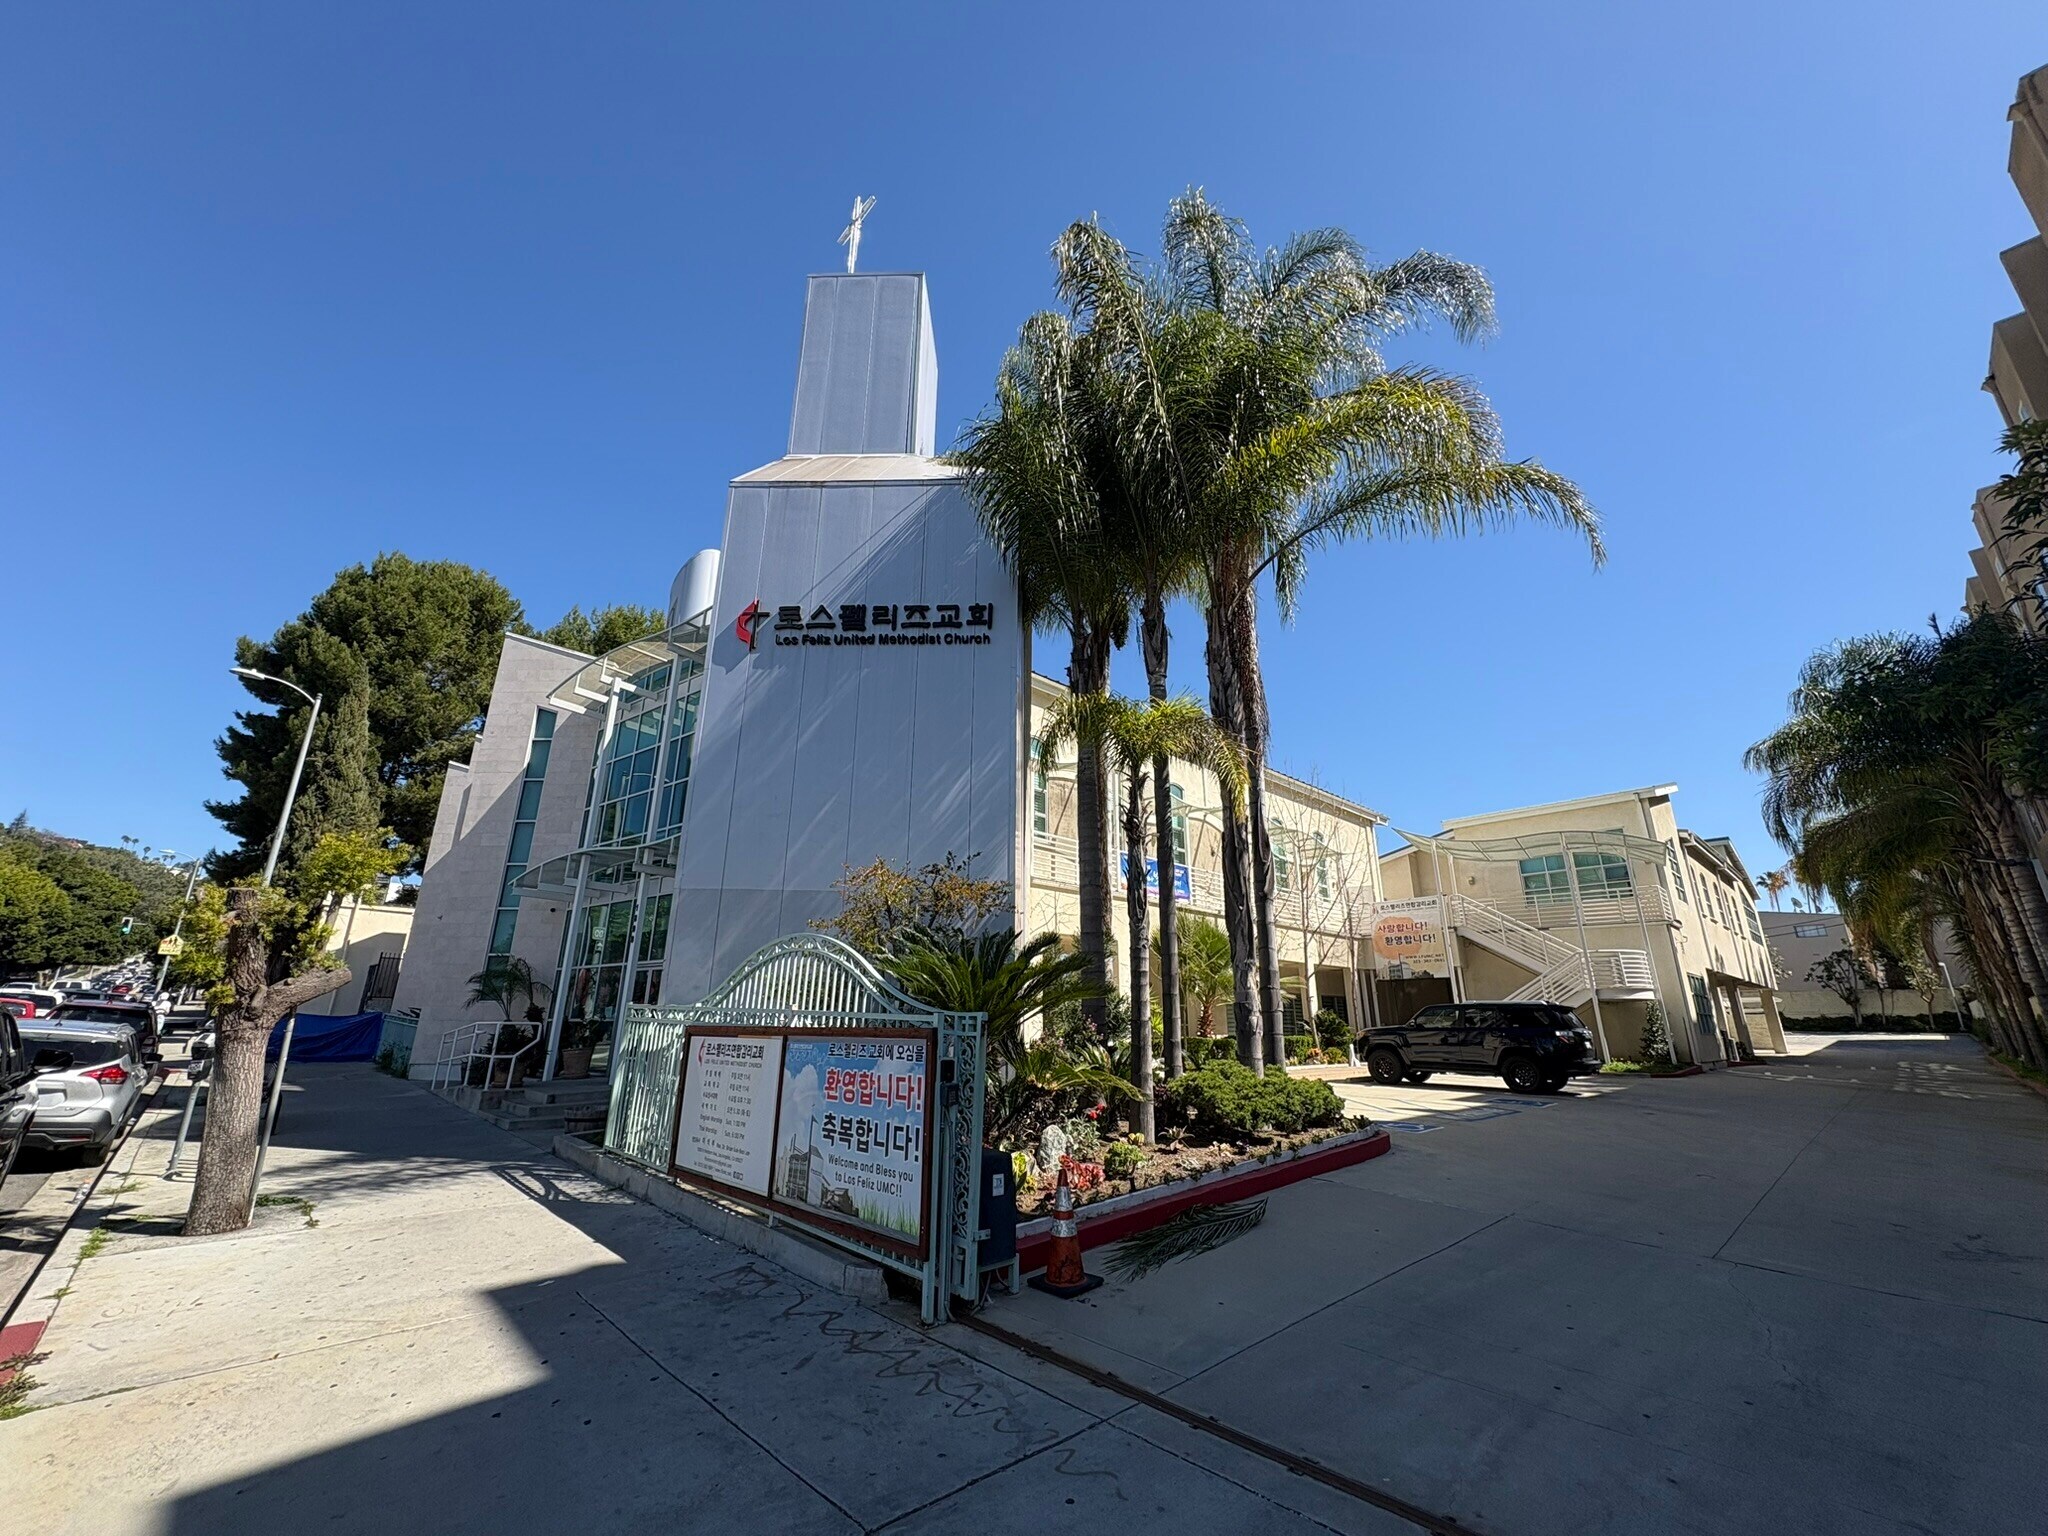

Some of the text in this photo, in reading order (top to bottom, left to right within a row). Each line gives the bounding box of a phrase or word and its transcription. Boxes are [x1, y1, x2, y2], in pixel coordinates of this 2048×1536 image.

[775, 632, 991, 646] Los Feliz United Methodist Church
[1378, 921, 1428, 933] 사랑합니다!
[1385, 934, 1436, 946] 환영합니다!
[868, 1044, 894, 1061] 교회에
[896, 1045, 925, 1062] 오심을
[824, 1068, 923, 1110] 환영합니다!
[821, 1112, 920, 1162] 축복합니다!
[828, 1153, 914, 1182] Welcome and Bless you
[835, 1171, 902, 1198] to Los Feliz UMC!!
